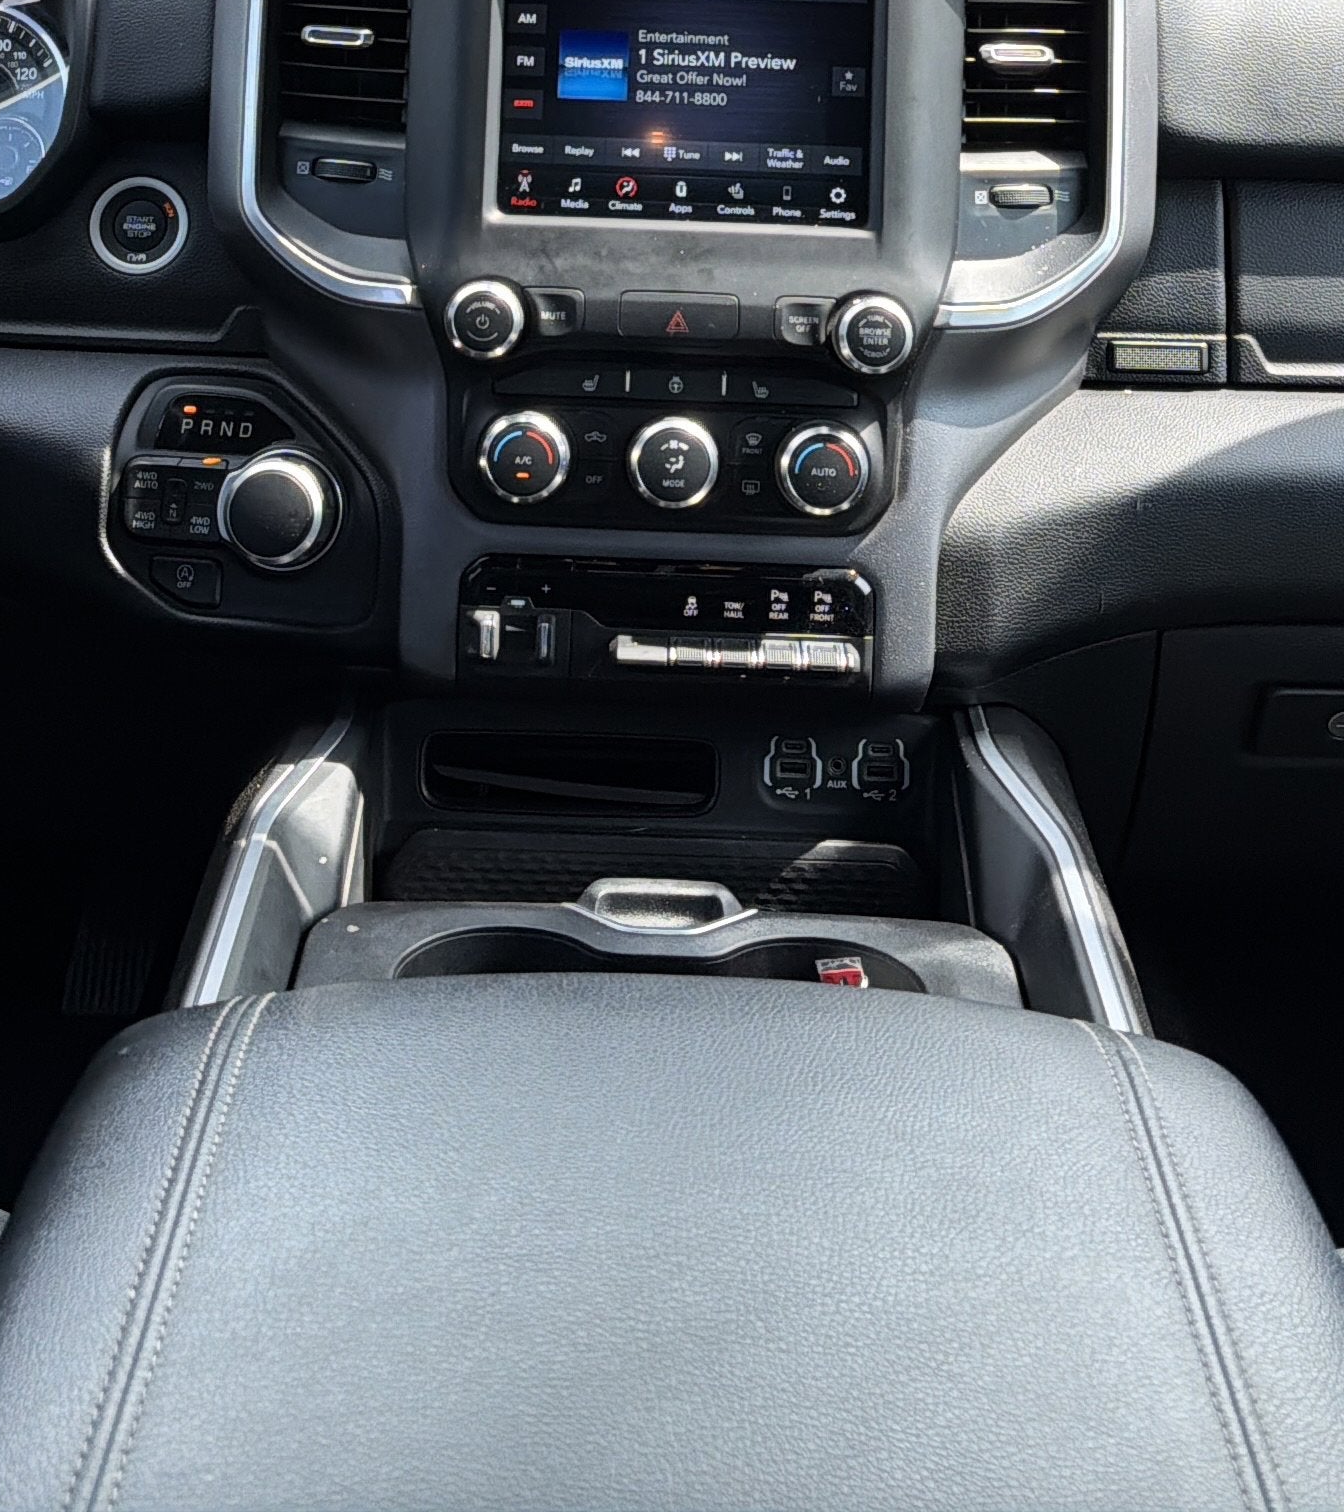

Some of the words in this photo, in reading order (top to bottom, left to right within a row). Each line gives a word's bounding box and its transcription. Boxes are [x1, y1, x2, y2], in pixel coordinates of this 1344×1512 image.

[517, 13, 537, 24] AM
[638, 29, 729, 45] Entertainment
[13, 51, 27, 60] 110
[639, 49, 645, 64] 1
[652, 49, 725, 67] SiriusXM
[730, 51, 797, 70] Preview
[516, 55, 535, 67] FM
[564, 56, 623, 70] SiriusXM
[15, 67, 38, 81] 120
[636, 70, 673, 85] Great
[676, 71, 711, 86] Offer
[713, 73, 747, 87] Now!
[839, 81, 858, 93] Fav
[636, 91, 728, 106] 844-711-8800
[511, 143, 544, 155] Browse
[564, 145, 594, 158] Replay
[767, 147, 795, 159] Traffic
[796, 148, 804, 159] &
[678, 150, 701, 160] Tune
[767, 159, 804, 170] Weather
[823, 155, 850, 167] Audio
[511, 196, 537, 207] Radio
[560, 198, 589, 209] Media
[608, 200, 643, 211] Climate
[669, 203, 693, 214] Apps
[716, 204, 755, 216] Controls
[772, 207, 801, 217] Phone
[126, 215, 154, 223] START
[819, 209, 856, 221] Settings
[123, 222, 156, 230] ENGINE
[127, 230, 152, 238] STOP
[540, 310, 567, 321] MUTE
[788, 316, 819, 324] SCREEN
[795, 325, 811, 333] OFF
[858, 328, 892, 336] BROWSE
[863, 336, 889, 345] ENTER
[180, 418, 194, 434] P
[200, 420, 213, 436] R
[219, 421, 234, 437] N
[239, 422, 253, 438] D
[514, 455, 533, 465] A/C
[136, 471, 158, 480] 4WD
[810, 467, 837, 477] AUTO
[134, 480, 159, 489] AUTO
[585, 475, 603, 484] OFF
[662, 479, 685, 488] MODE
[193, 481, 215, 489] 2WD
[135, 511, 156, 521] 4WD
[190, 516, 211, 525] 4WD
[132, 520, 155, 529] HIGH
[189, 525, 211, 534] LOW
[177, 581, 192, 589] OFF
[771, 603, 787, 611] OFF
[814, 604, 831, 612] OFF
[683, 609, 699, 617] OFF
[723, 610, 745, 619] HAUL
[768, 612, 789, 620] REAR
[809, 614, 835, 622] FRONT
[826, 779, 848, 789] AUX
[804, 788, 811, 800] 1
[889, 789, 897, 802] 2
